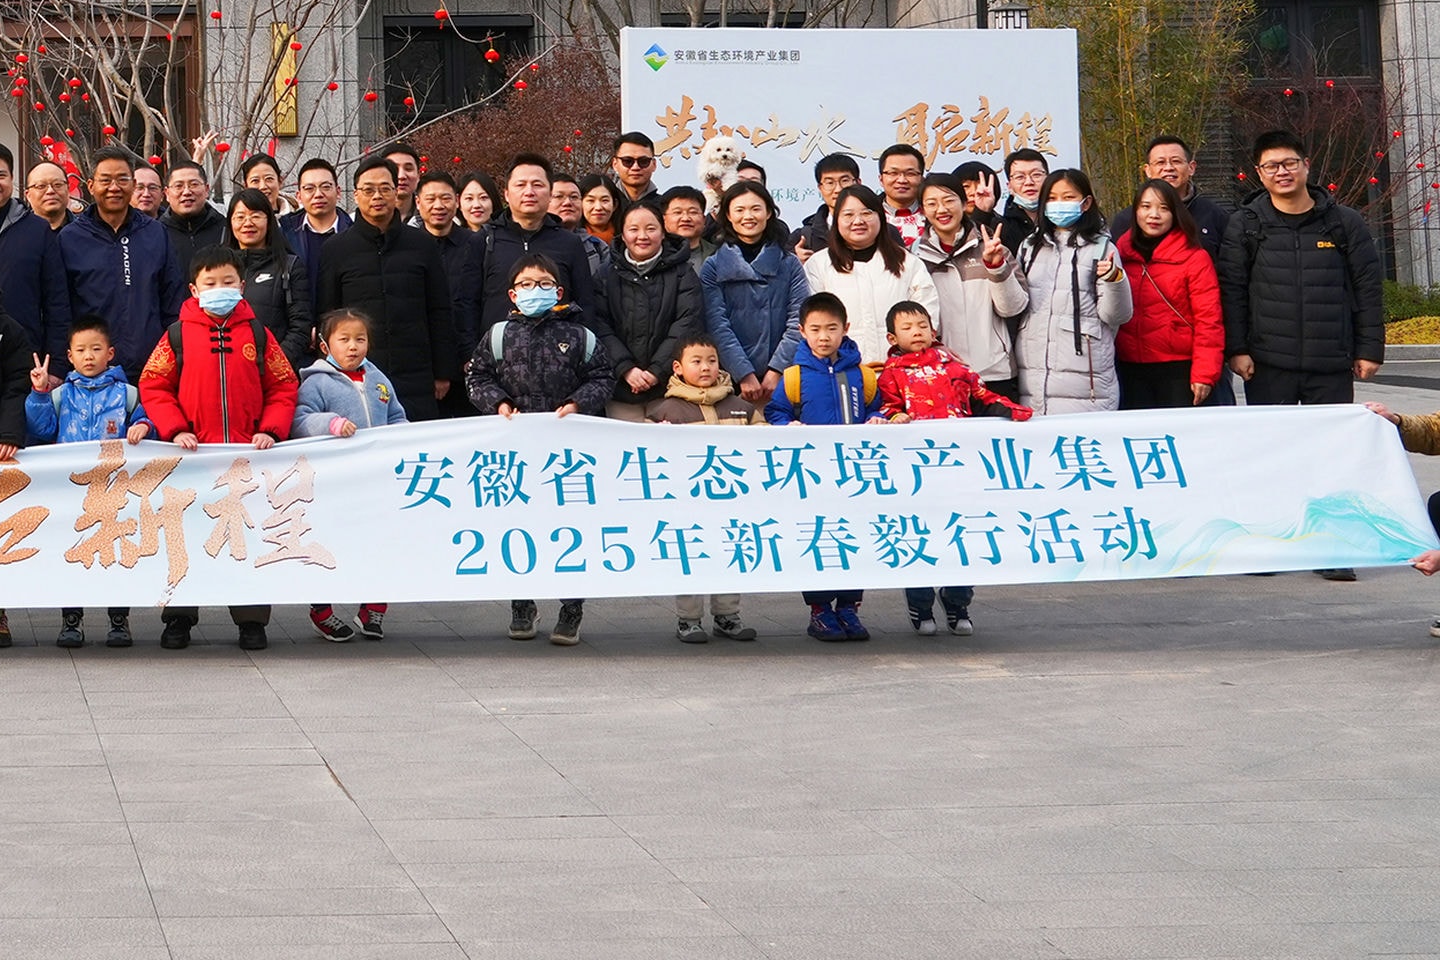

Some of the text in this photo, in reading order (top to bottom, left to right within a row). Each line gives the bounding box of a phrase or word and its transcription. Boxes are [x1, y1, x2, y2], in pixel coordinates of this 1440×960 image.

[674, 49, 801, 61] 安徽省生态环境产业集团
[394, 433, 1188, 510] 安徽省生态环境产业集团
[452, 505, 1159, 577] 2025年新春毅行活动
